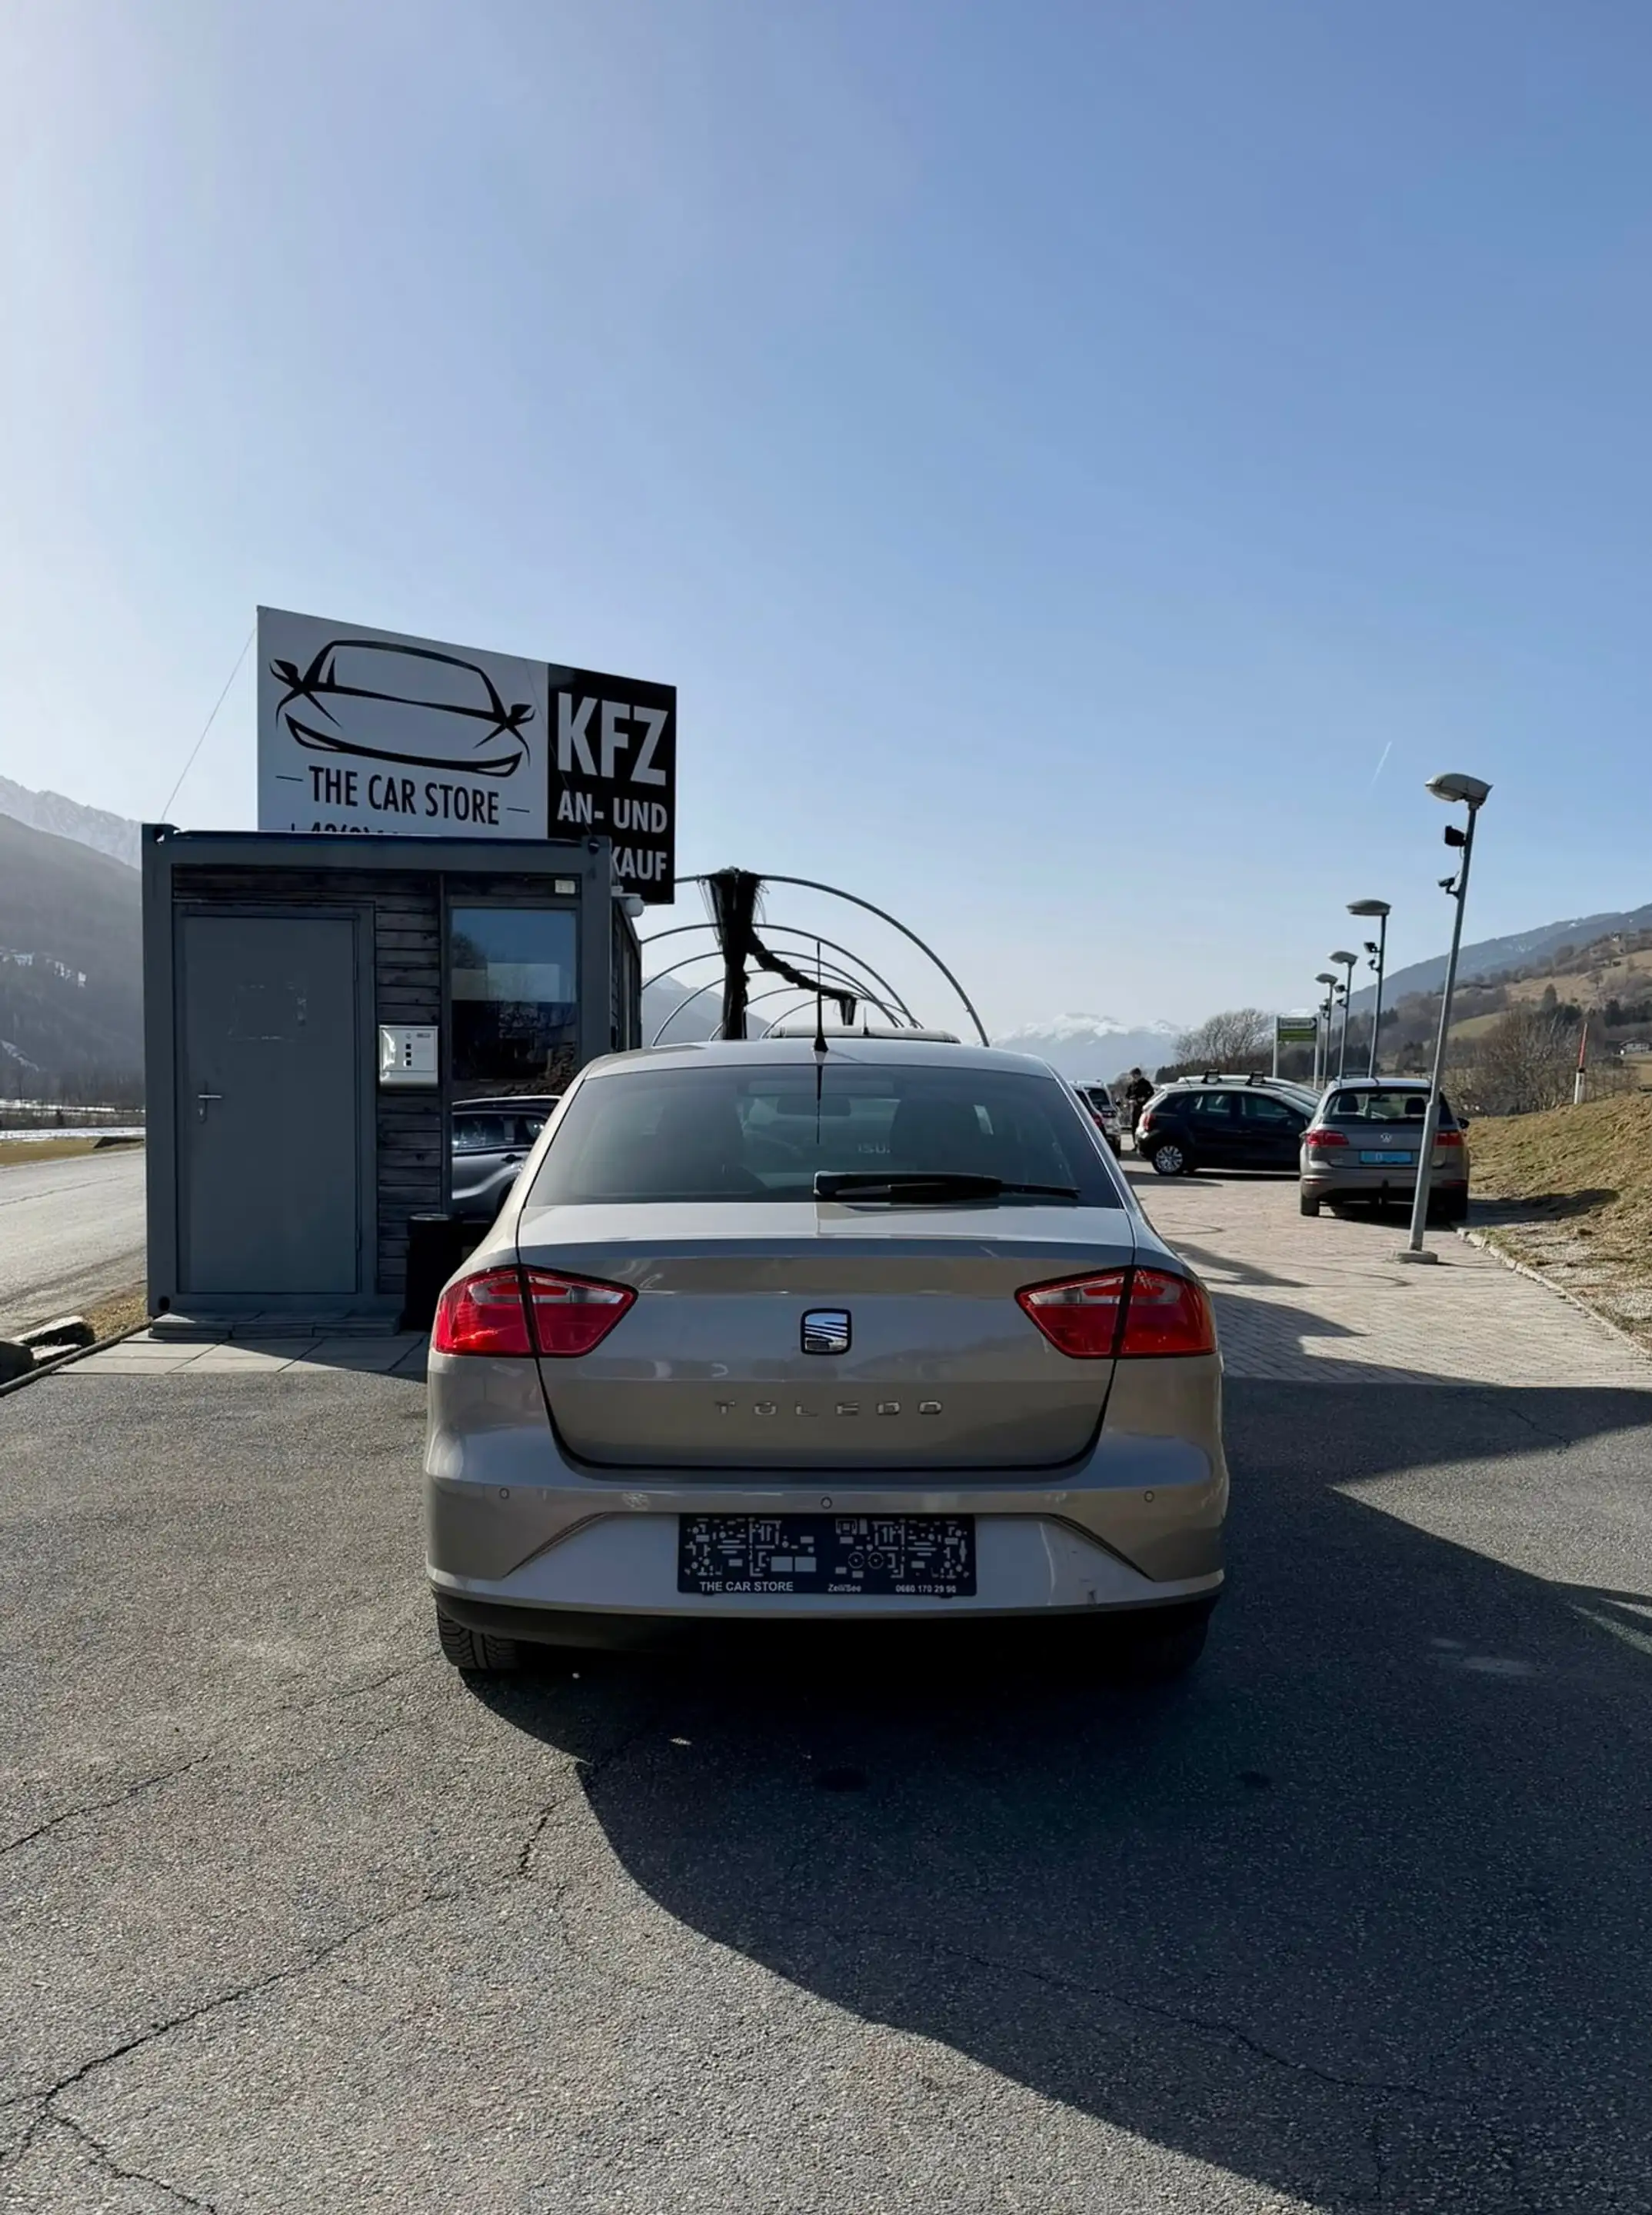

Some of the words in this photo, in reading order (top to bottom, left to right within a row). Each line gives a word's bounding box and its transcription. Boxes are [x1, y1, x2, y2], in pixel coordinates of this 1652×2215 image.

[558, 692, 668, 786] KFZ
[308, 765, 358, 807] THE
[368, 774, 417, 814] CAR
[425, 782, 499, 825] STORE
[557, 790, 604, 824] AN-
[613, 802, 668, 833] UND
[715, 1401, 943, 1417] TOLEDO
[699, 1581, 723, 1592] THE
[725, 1581, 751, 1592] CAR
[754, 1581, 794, 1592] STORE
